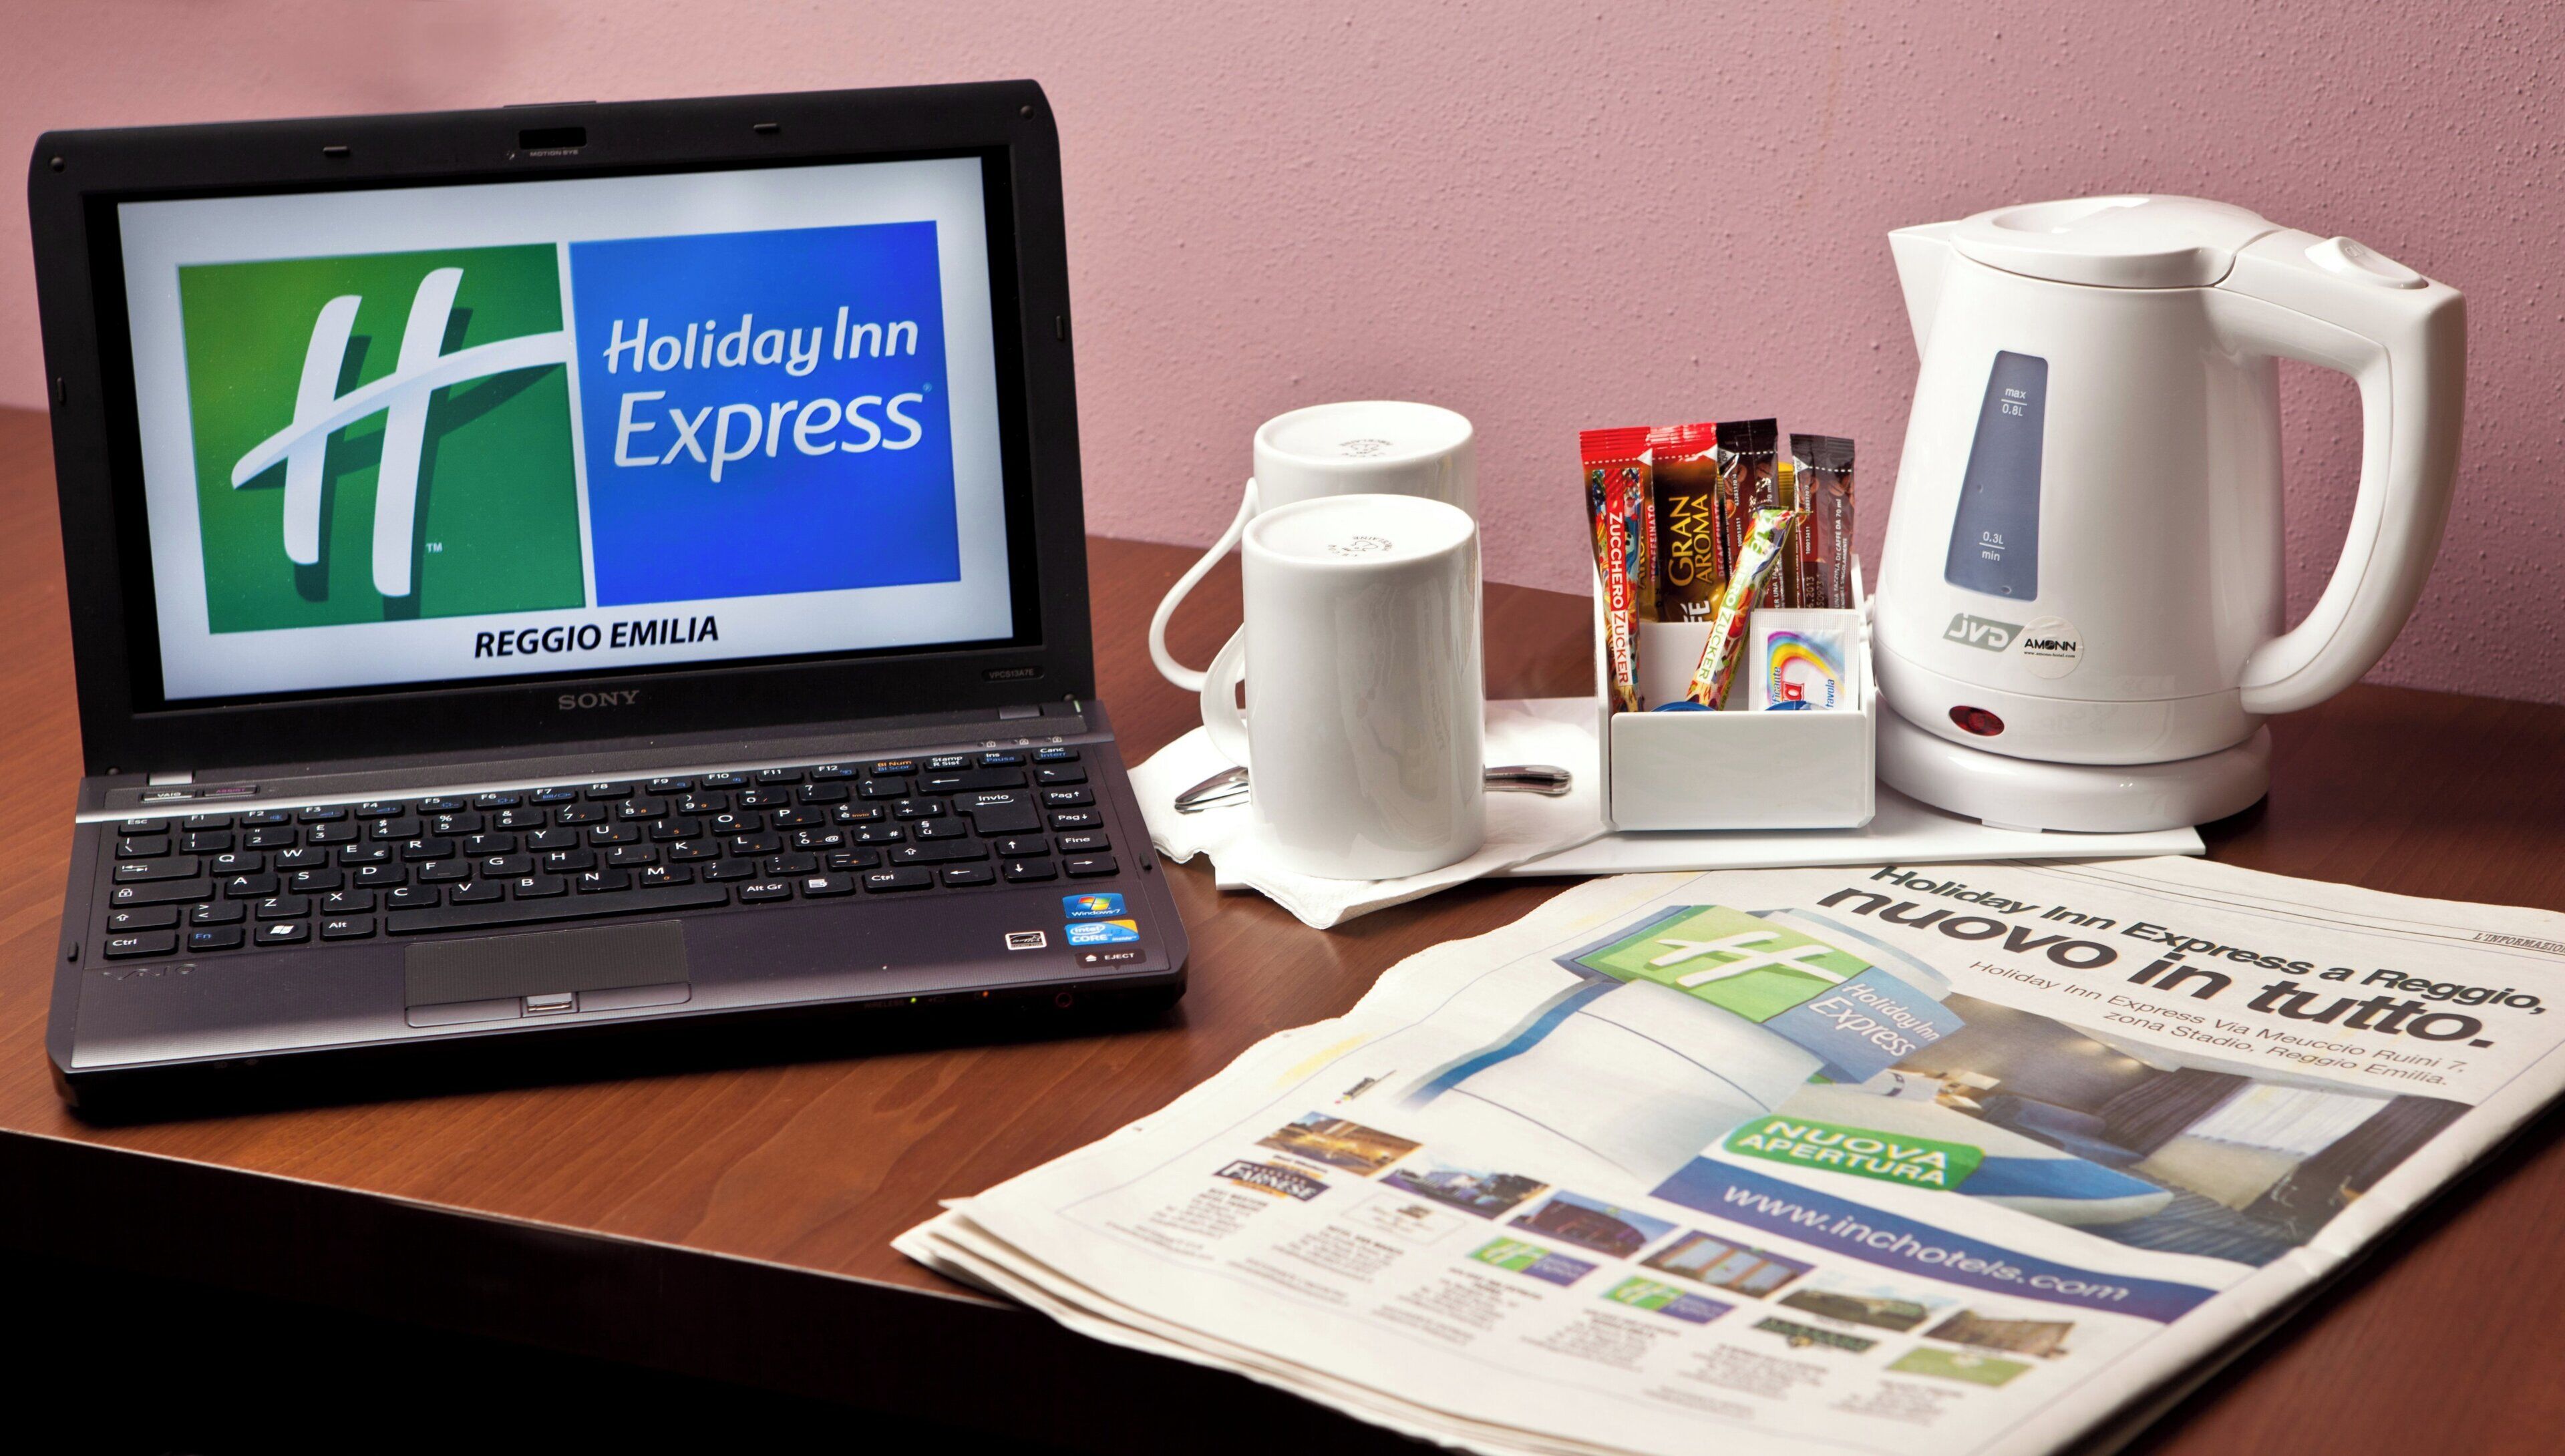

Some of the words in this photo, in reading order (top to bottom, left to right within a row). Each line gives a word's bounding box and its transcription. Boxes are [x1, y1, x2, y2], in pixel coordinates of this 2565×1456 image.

[603, 314, 823, 376] Holiday
[833, 306, 918, 361] Inn
[2005, 387, 2026, 399] max
[2002, 403, 2023, 417] 0.8L
[614, 390, 923, 483] Express
[1836, 509, 1842, 517] 70
[1836, 520, 1842, 530] DA
[1668, 496, 1694, 586] GRAN
[1691, 494, 1713, 583] AROMA
[1983, 531, 2004, 544] 0.3L
[1608, 512, 1624, 608] ZUCCHERO
[1982, 550, 2001, 562] min
[474, 624, 602, 659] REGGIO
[609, 615, 719, 649] EMILIA
[1612, 611, 1629, 683] ZUCKER
[1699, 610, 1733, 679] ZUCKER
[557, 689, 640, 710] SONY
[1825, 679, 1834, 708] tavola
[979, 793, 1009, 801] Invio
[780, 809, 791, 817] P
[534, 831, 546, 839] Y
[347, 845, 357, 853] E
[614, 848, 622, 856] J
[675, 842, 688, 850] K
[219, 854, 235, 864] Q
[283, 849, 303, 858] W
[298, 872, 309, 880] S
[584, 872, 598, 881] N
[647, 867, 665, 875] M
[233, 877, 248, 885] A
[330, 893, 343, 901] X
[393, 888, 408, 896] C
[264, 899, 277, 907] Z
[1071, 924, 1102, 933] intel
[112, 938, 137, 946] Ctrl
[1072, 934, 1107, 942] CORE
[1870, 866, 2041, 914] Holiday
[2040, 905, 2117, 930] Inn
[2120, 922, 2315, 976] Express
[2319, 967, 2356, 982] a
[2360, 968, 2547, 1014] Reggio,
[1105, 952, 1134, 960] EJECT
[1816, 888, 2119, 969] nuovo
[2127, 952, 2232, 1000] in
[2246, 980, 2495, 1049] tutto.
[1842, 983, 1920, 1029] Holiday
[1912, 1021, 1940, 1041] Inn
[1969, 961, 2061, 990] Holiday
[2063, 984, 2103, 1000] Inn
[2107, 994, 2206, 1025] Express
[2214, 1018, 2252, 1037] Via
[2256, 1027, 2366, 1056] Meuccio
[2373, 1049, 2443, 1069] Ruini
[1808, 996, 1916, 1057] Express
[2103, 1012, 2166, 1032] zona
[2170, 1026, 2256, 1053] Stadio,
[2265, 1045, 2357, 1070] Reggio
[2363, 1063, 2447, 1086] Emilia.
[1762, 1121, 1948, 1171] NUOVA
[1738, 1133, 1947, 1187] APERTURA
[1722, 1184, 2130, 1304] www.inchotels.com
